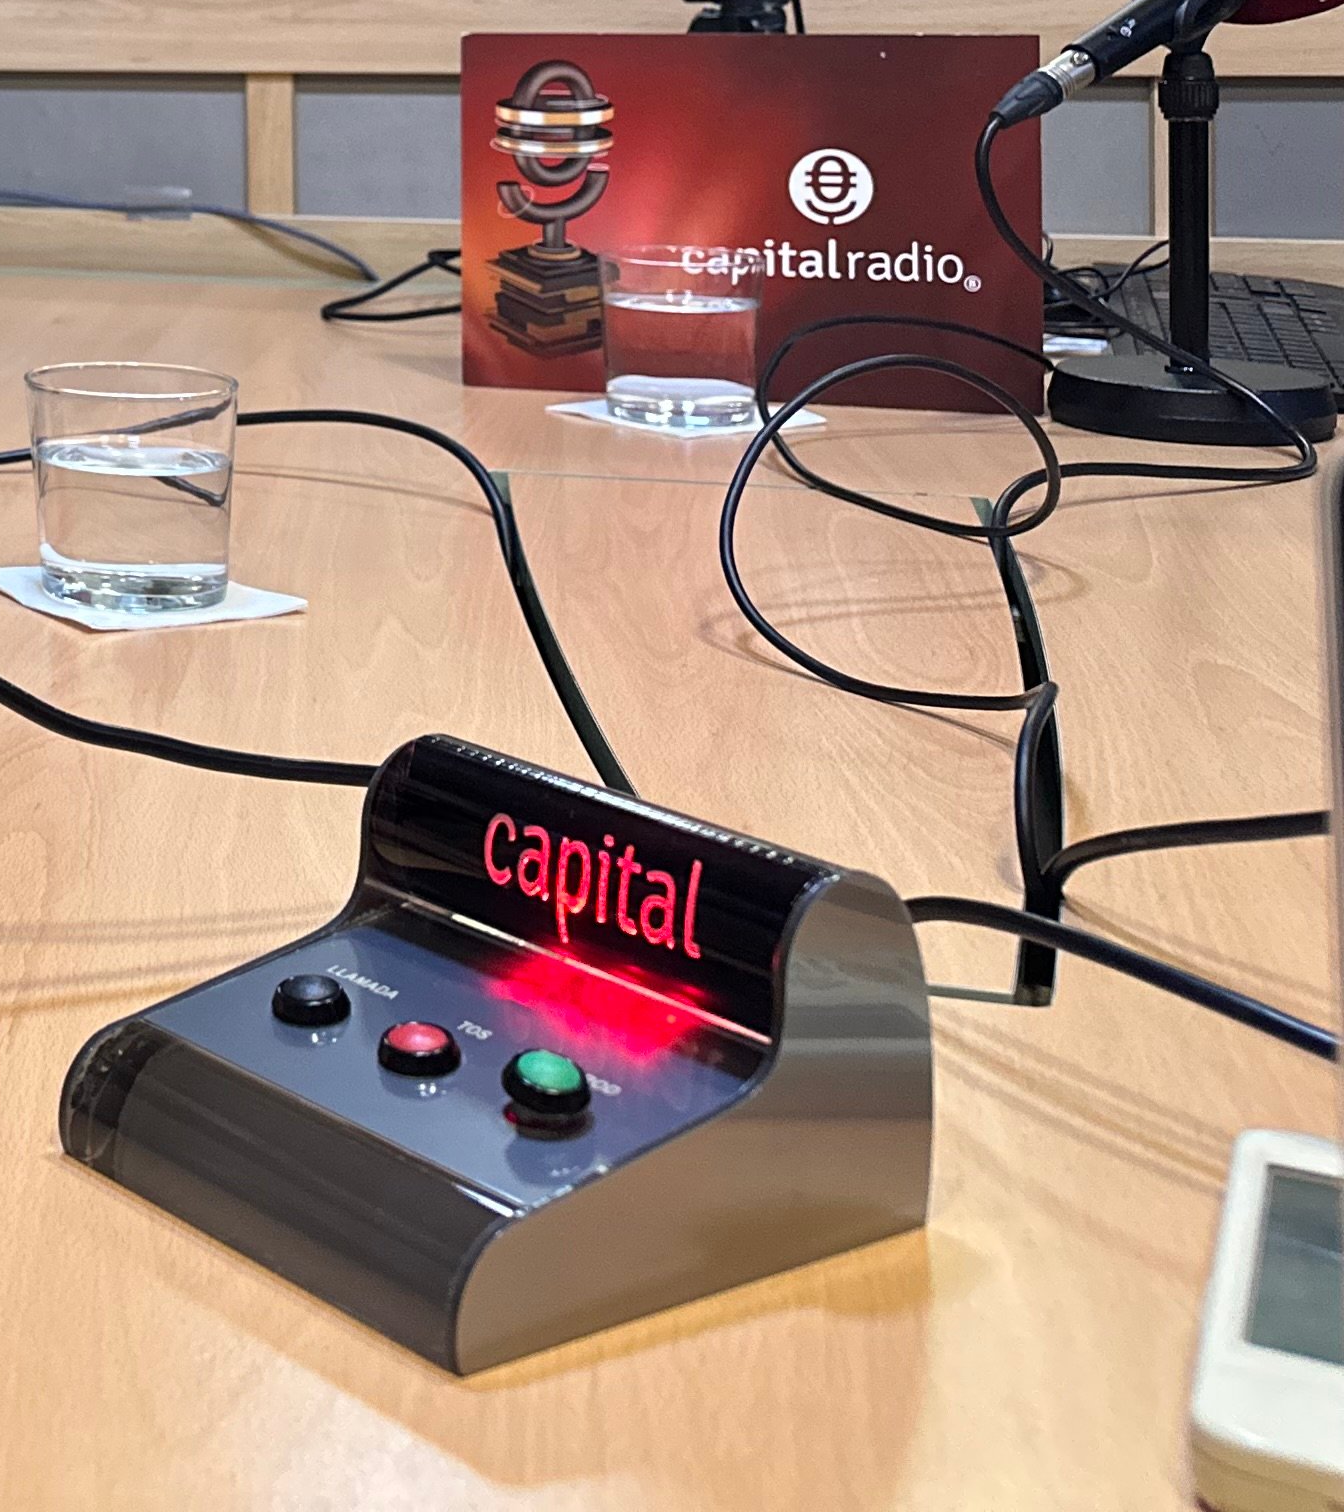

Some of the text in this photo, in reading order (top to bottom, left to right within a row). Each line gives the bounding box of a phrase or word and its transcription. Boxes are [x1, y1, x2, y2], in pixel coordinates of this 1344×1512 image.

[483, 812, 703, 960] capital
[326, 964, 400, 1001] LLAMADA
[456, 1019, 494, 1042] TOS
